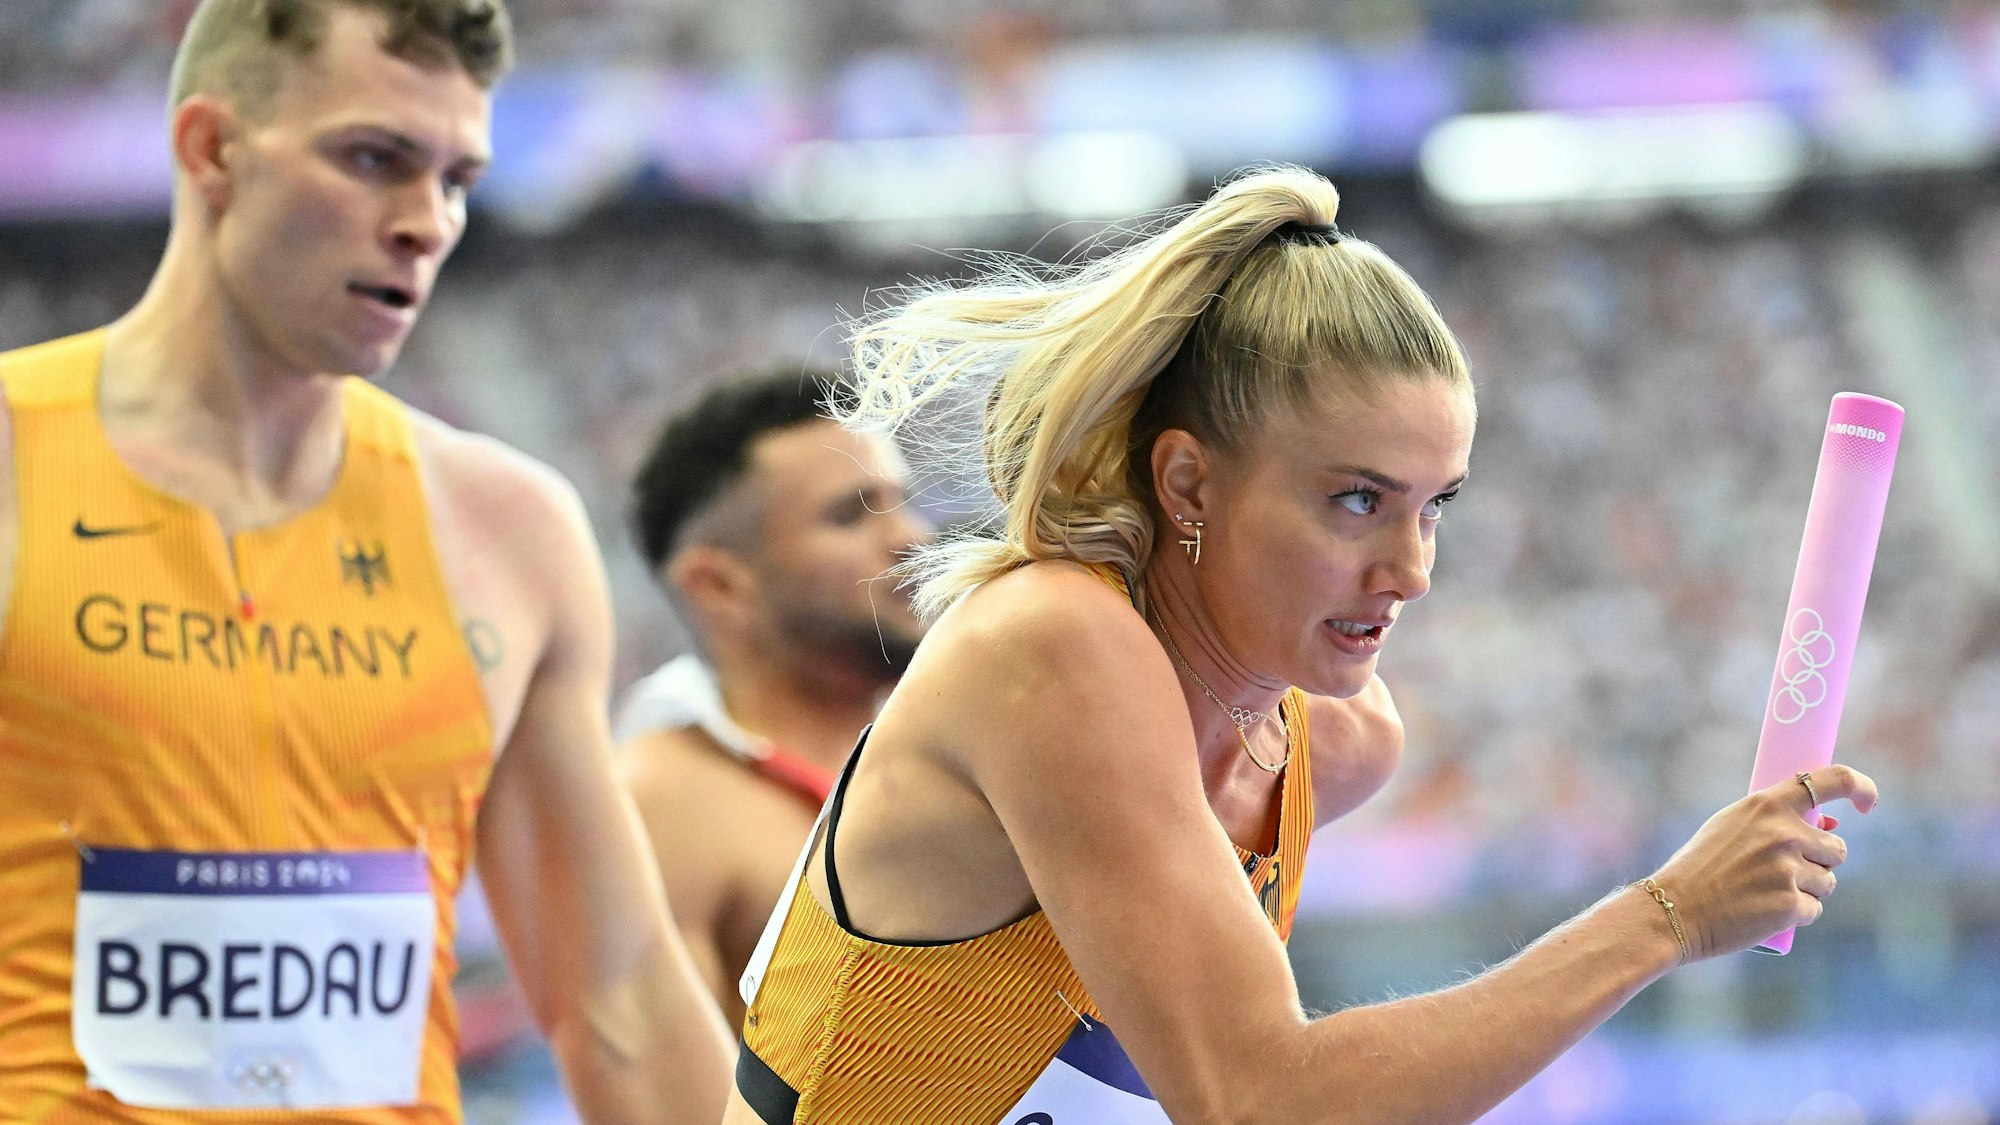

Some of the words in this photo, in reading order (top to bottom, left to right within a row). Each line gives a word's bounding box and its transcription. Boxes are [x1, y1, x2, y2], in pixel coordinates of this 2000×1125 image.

[1834, 423, 1886, 442] MONDO
[75, 593, 417, 678] GERMANY
[176, 859, 270, 888] PARIS
[276, 859, 350, 888] 2024
[97, 940, 415, 1018] BREDAU
